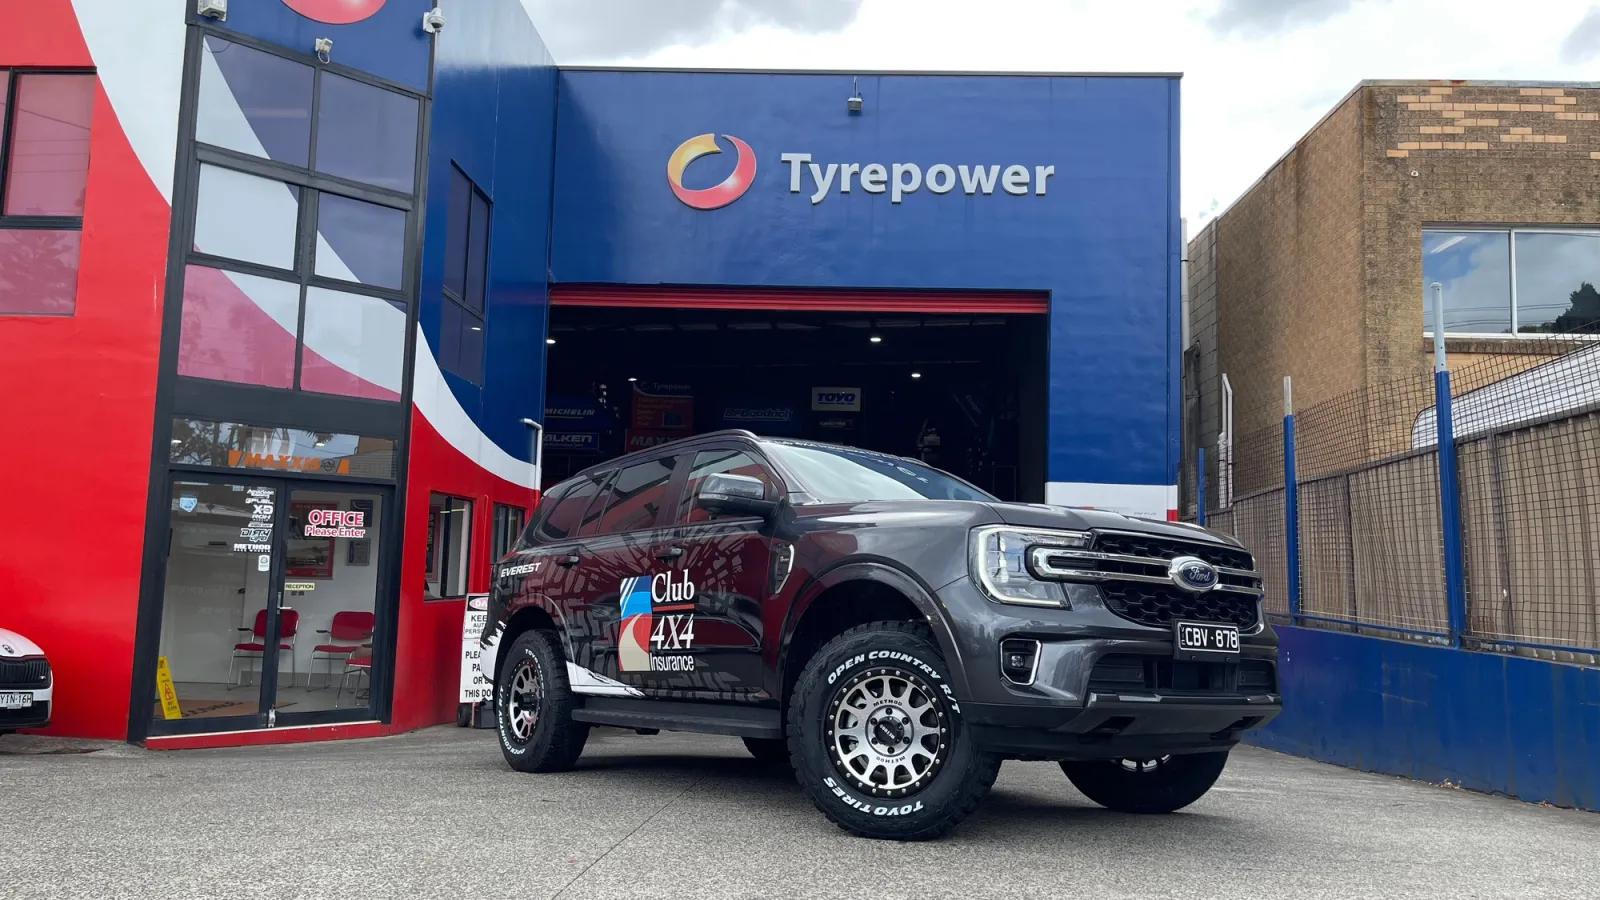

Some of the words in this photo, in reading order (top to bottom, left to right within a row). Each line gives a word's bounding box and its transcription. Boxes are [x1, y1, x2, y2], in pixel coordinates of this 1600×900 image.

[781, 152, 1054, 205] Tyrepower
[817, 393, 856, 402] TOYO
[544, 408, 596, 416] MICHELIN
[543, 434, 593, 443] ALKEN
[244, 453, 320, 471] MAXXIS
[309, 509, 364, 527] OFFICE
[305, 525, 337, 538] Please
[338, 527, 366, 539] Enter
[501, 562, 541, 578] EVEREST
[1189, 566, 1211, 582] Ford
[652, 569, 694, 603] Club
[650, 613, 694, 650] 4X4
[465, 651, 481, 659] PLEA
[649, 652, 694, 671] Insurance
[827, 654, 865, 685] OPEN
[868, 650, 942, 680] COUNTRY
[940, 684, 961, 714] R/T
[464, 690, 480, 698] THIS
[873, 699, 903, 708] METHOD
[823, 776, 871, 814] TIRES
[873, 801, 924, 816] TOYO
